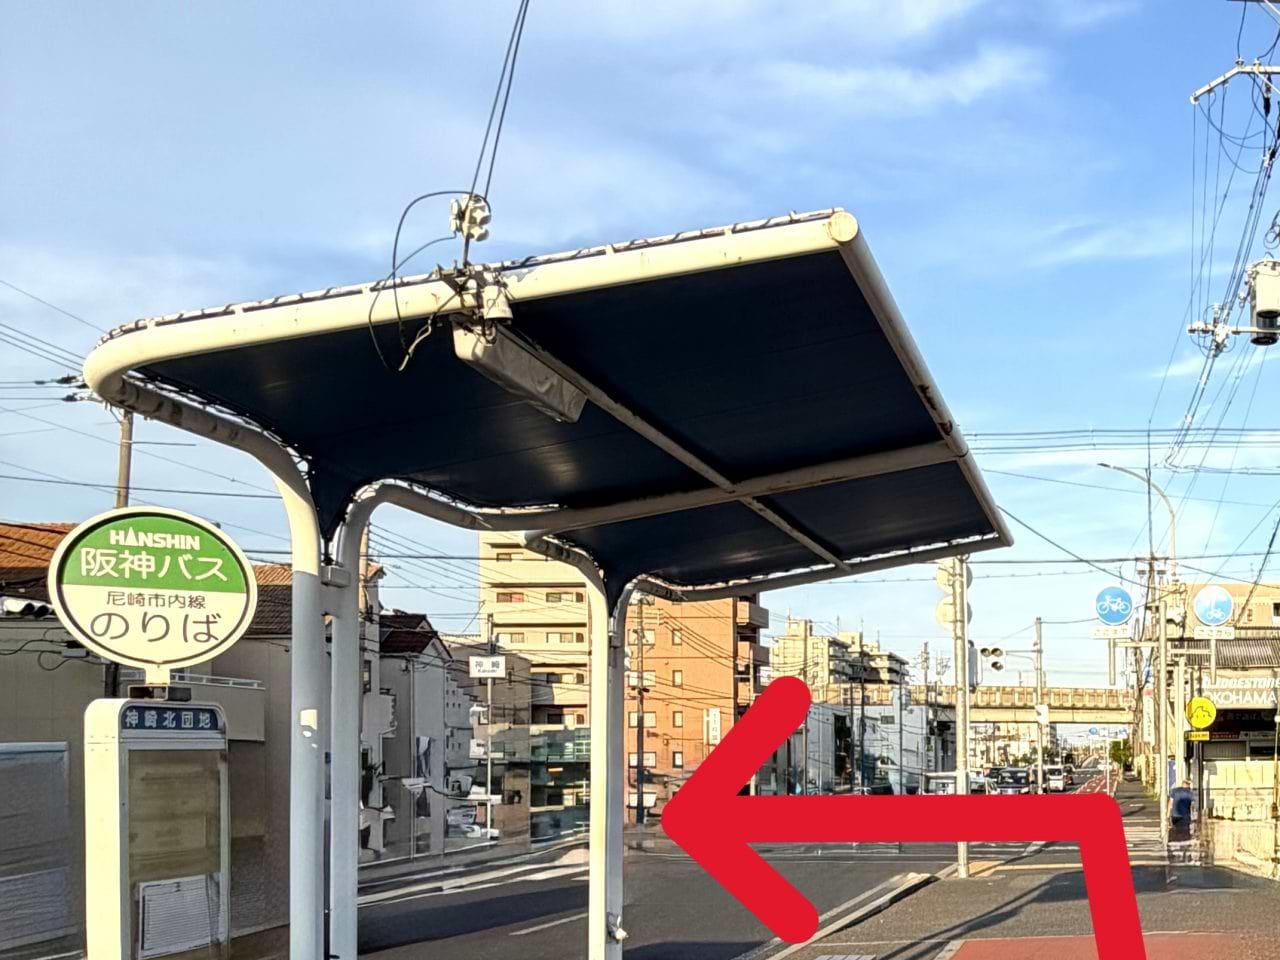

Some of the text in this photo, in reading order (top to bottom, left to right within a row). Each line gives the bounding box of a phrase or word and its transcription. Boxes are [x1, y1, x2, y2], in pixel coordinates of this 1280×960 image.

[109, 527, 200, 550] HANSHIN
[81, 547, 228, 581] 阪神バス
[106, 591, 206, 609] 尼崎市内線
[89, 611, 222, 643] のりば
[125, 709, 211, 728] 神崎北団地
